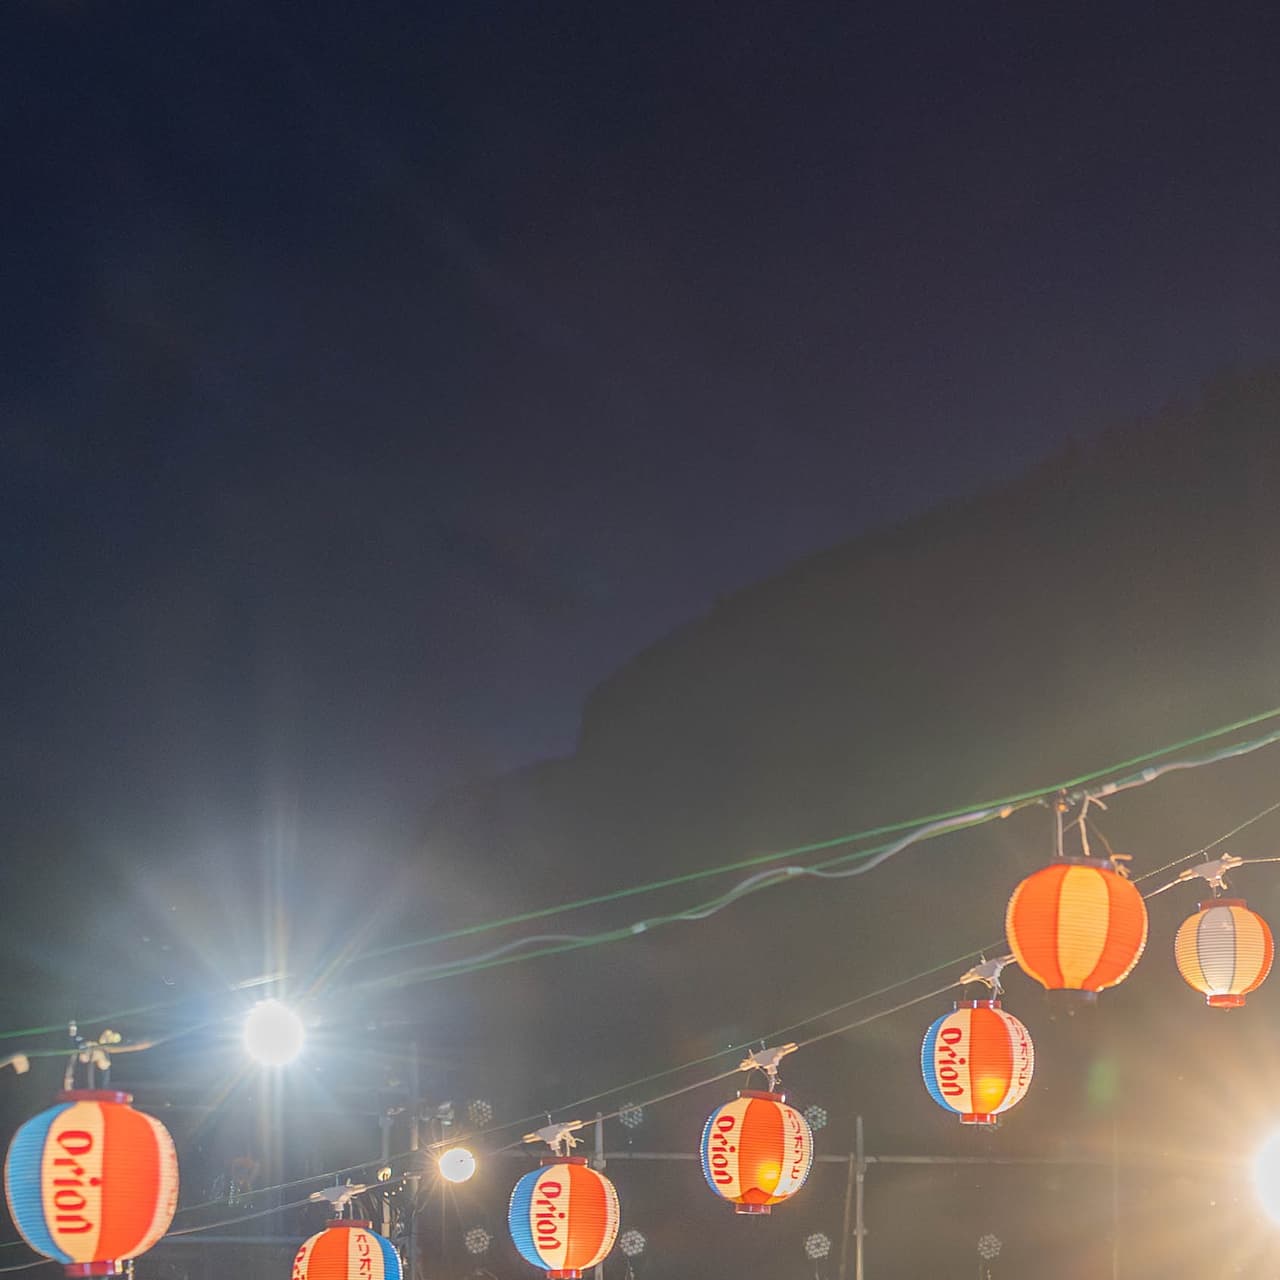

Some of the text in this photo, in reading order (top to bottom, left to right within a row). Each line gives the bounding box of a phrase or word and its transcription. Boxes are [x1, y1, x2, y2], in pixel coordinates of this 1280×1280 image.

[938, 1028, 966, 1096] Orion
[53, 1130, 102, 1234] Orion
[712, 1115, 735, 1184] Orion
[536, 1181, 565, 1250] Orion
